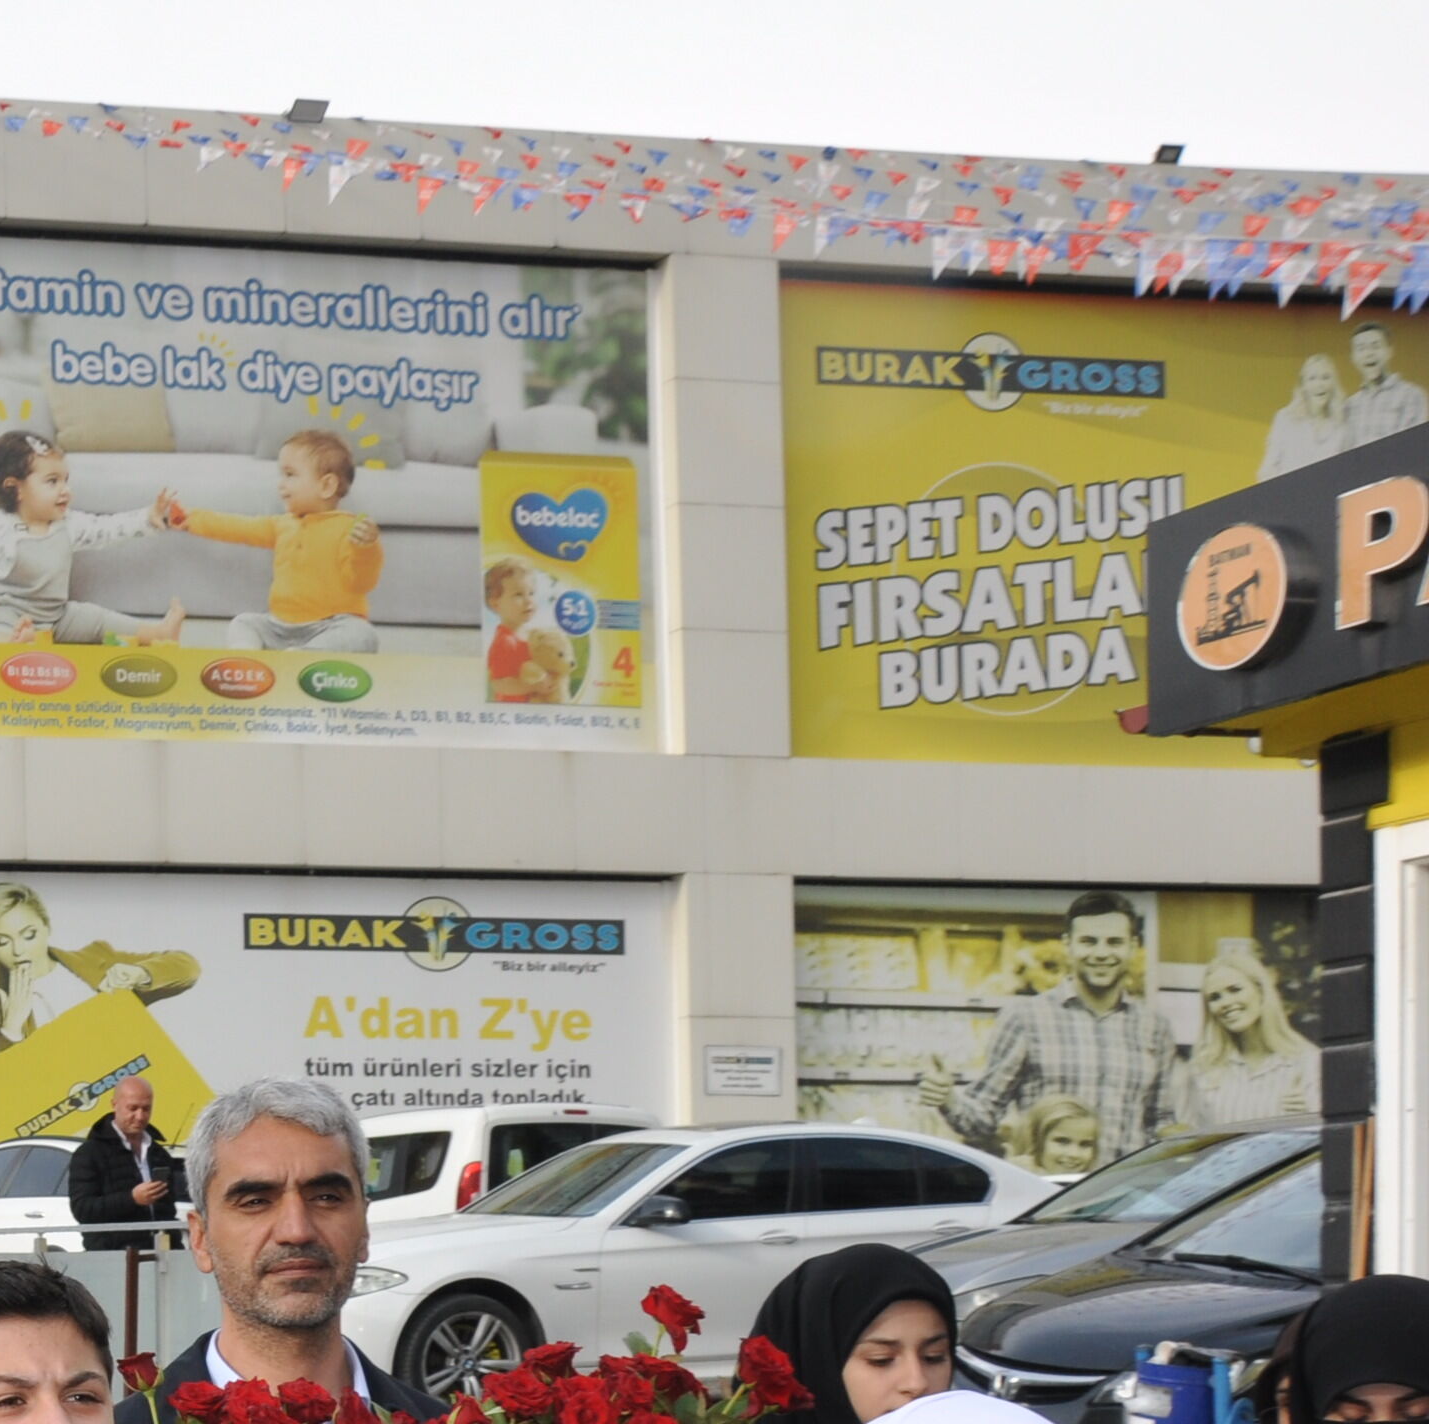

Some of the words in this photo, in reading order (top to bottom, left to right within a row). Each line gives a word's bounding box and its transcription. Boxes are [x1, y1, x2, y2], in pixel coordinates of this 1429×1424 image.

[135, 283, 192, 320] ve
[204, 279, 488, 337] minerallerini
[51, 340, 156, 386] bebe
[162, 345, 226, 391] lak
[239, 350, 321, 404] diye
[328, 357, 479, 412] paylaşır
[820, 350, 965, 386] BURAK
[1017, 360, 1161, 395] GROSS
[515, 505, 600, 529] bebelac
[815, 496, 963, 571] SEPET
[1335, 475, 1429, 631] P
[817, 550, 1149, 651] FIRSATLA
[116, 668, 161, 683] Demir
[312, 672, 358, 691] Çinko
[613, 646, 635, 678] 4
[879, 626, 1138, 709] BURADA
[248, 917, 406, 948] BURAK
[465, 921, 620, 951] GROSS
[527, 960, 546, 973] bir
[303, 996, 460, 1040] A'dan
[479, 997, 593, 1052] Z'ye
[305, 1058, 353, 1079] tüm
[364, 1057, 462, 1079] ürünleri
[471, 1058, 538, 1080] sizler
[546, 1060, 591, 1083] için
[17, 1098, 76, 1138] BURAK
[91, 1056, 149, 1095] GROSS
[350, 1091, 395, 1111] çatı
[404, 1089, 483, 1107] altında
